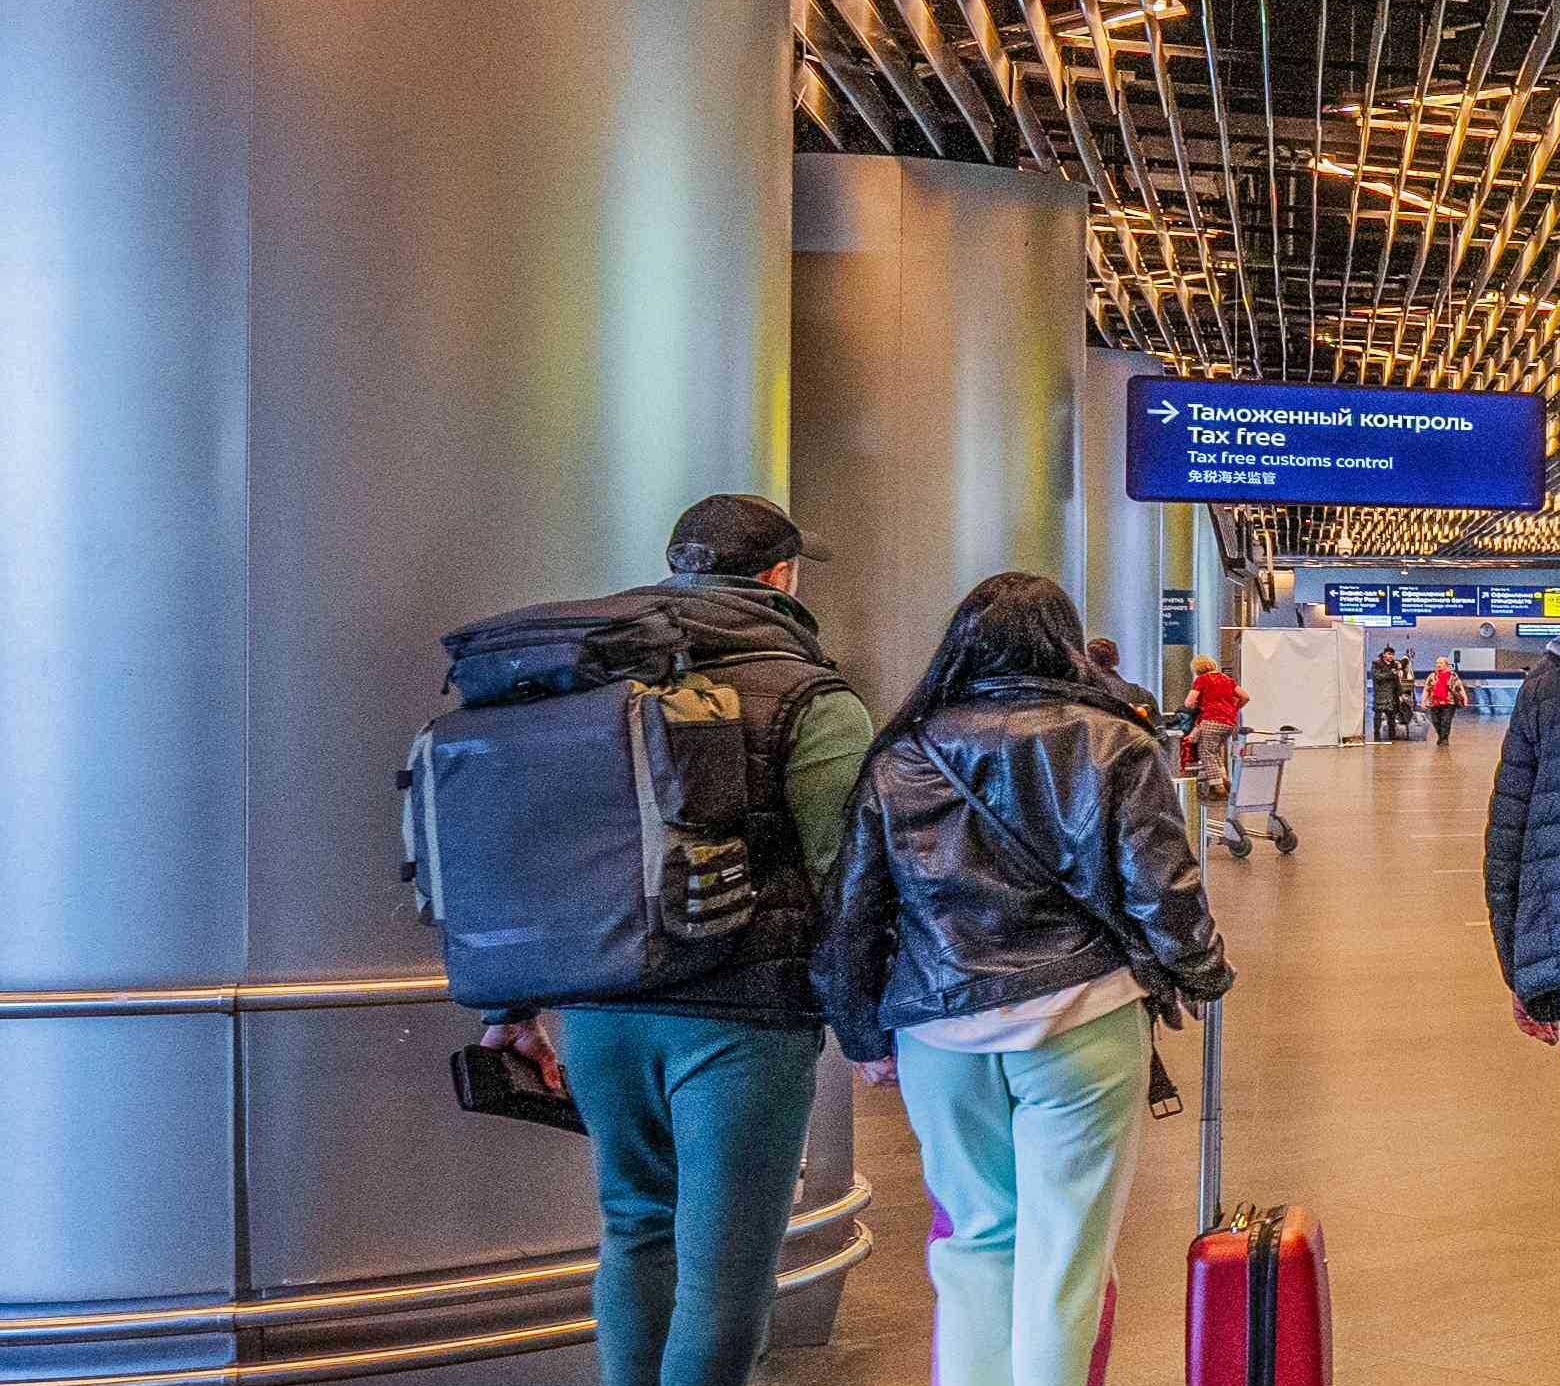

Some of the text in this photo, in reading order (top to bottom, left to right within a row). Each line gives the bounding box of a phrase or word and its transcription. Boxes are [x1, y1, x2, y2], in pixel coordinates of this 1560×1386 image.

[1187, 402, 1473, 433] Таможенный контроль
[1187, 426, 1286, 447] Tax free
[1187, 450, 1393, 470] Tax free customs control
[1187, 469, 1276, 485] 免税海关监管
